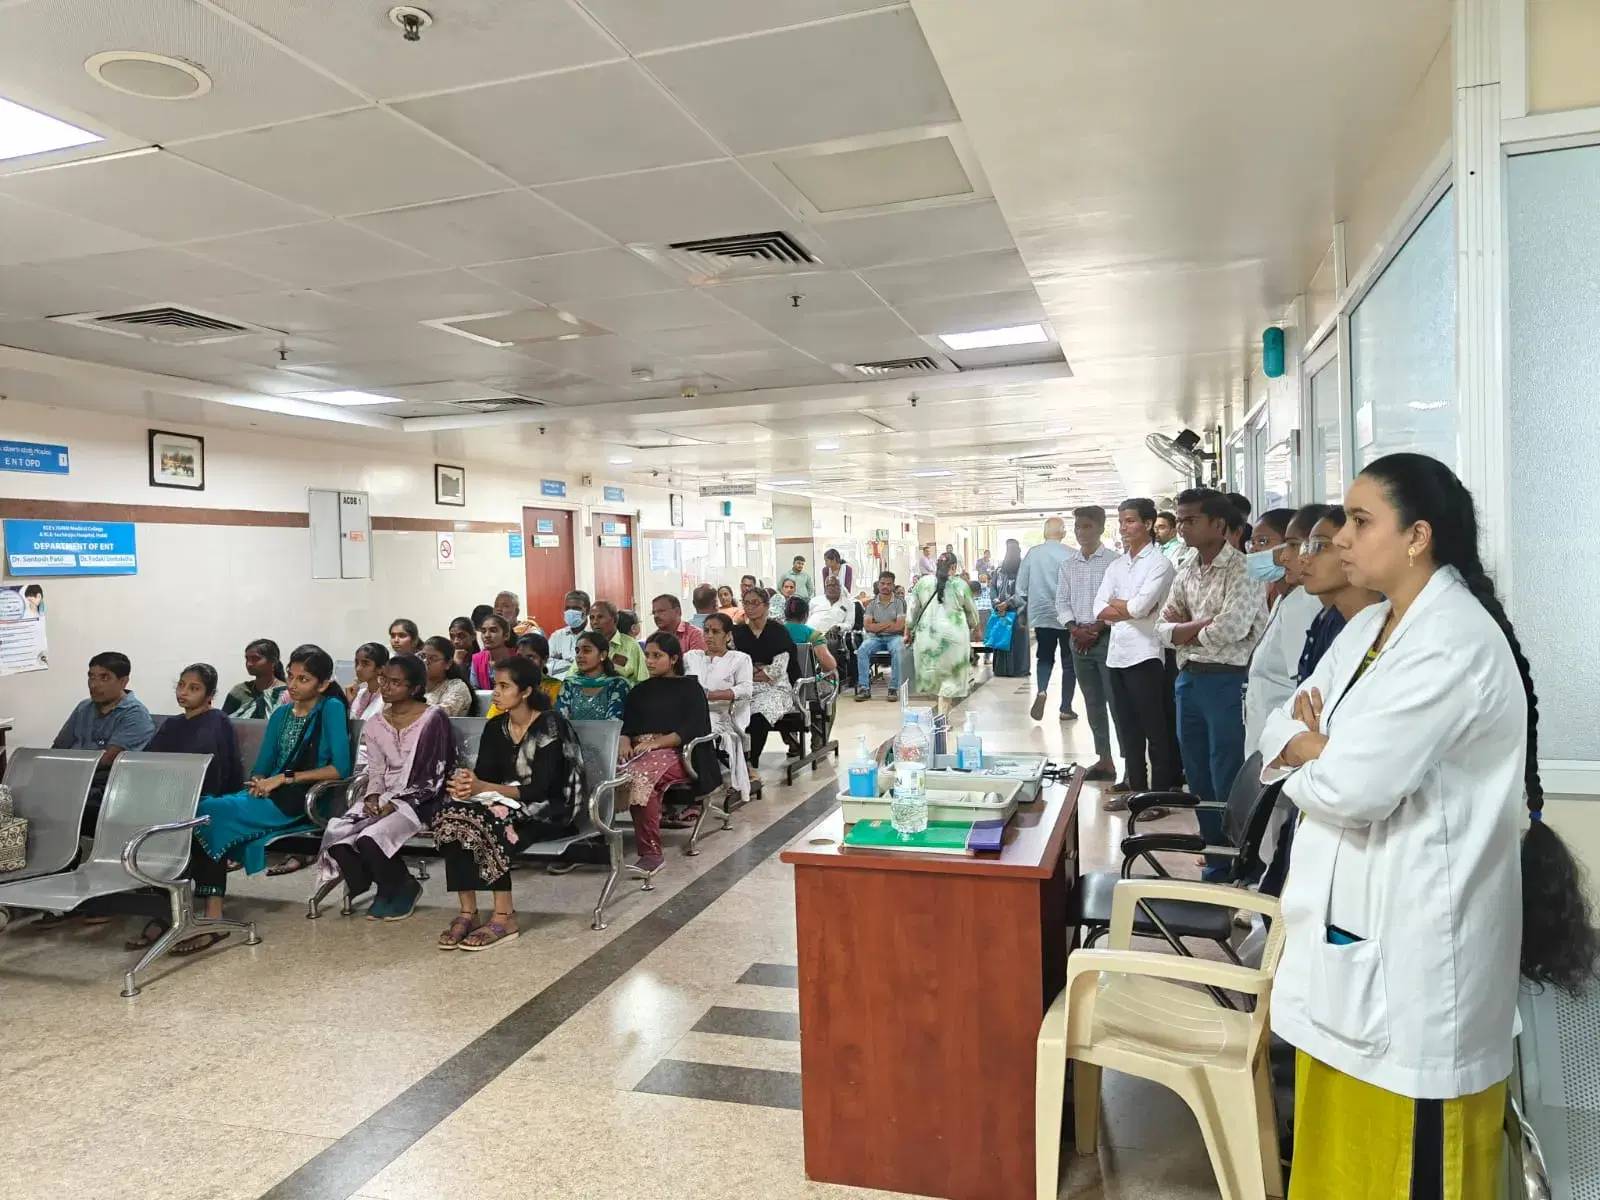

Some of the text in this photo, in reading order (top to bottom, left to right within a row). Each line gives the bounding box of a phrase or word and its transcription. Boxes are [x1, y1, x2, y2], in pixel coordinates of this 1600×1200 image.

[25, 459, 41, 467] OPD
[33, 542, 86, 551] DEPARTMENT
[100, 543, 114, 551] ENT
